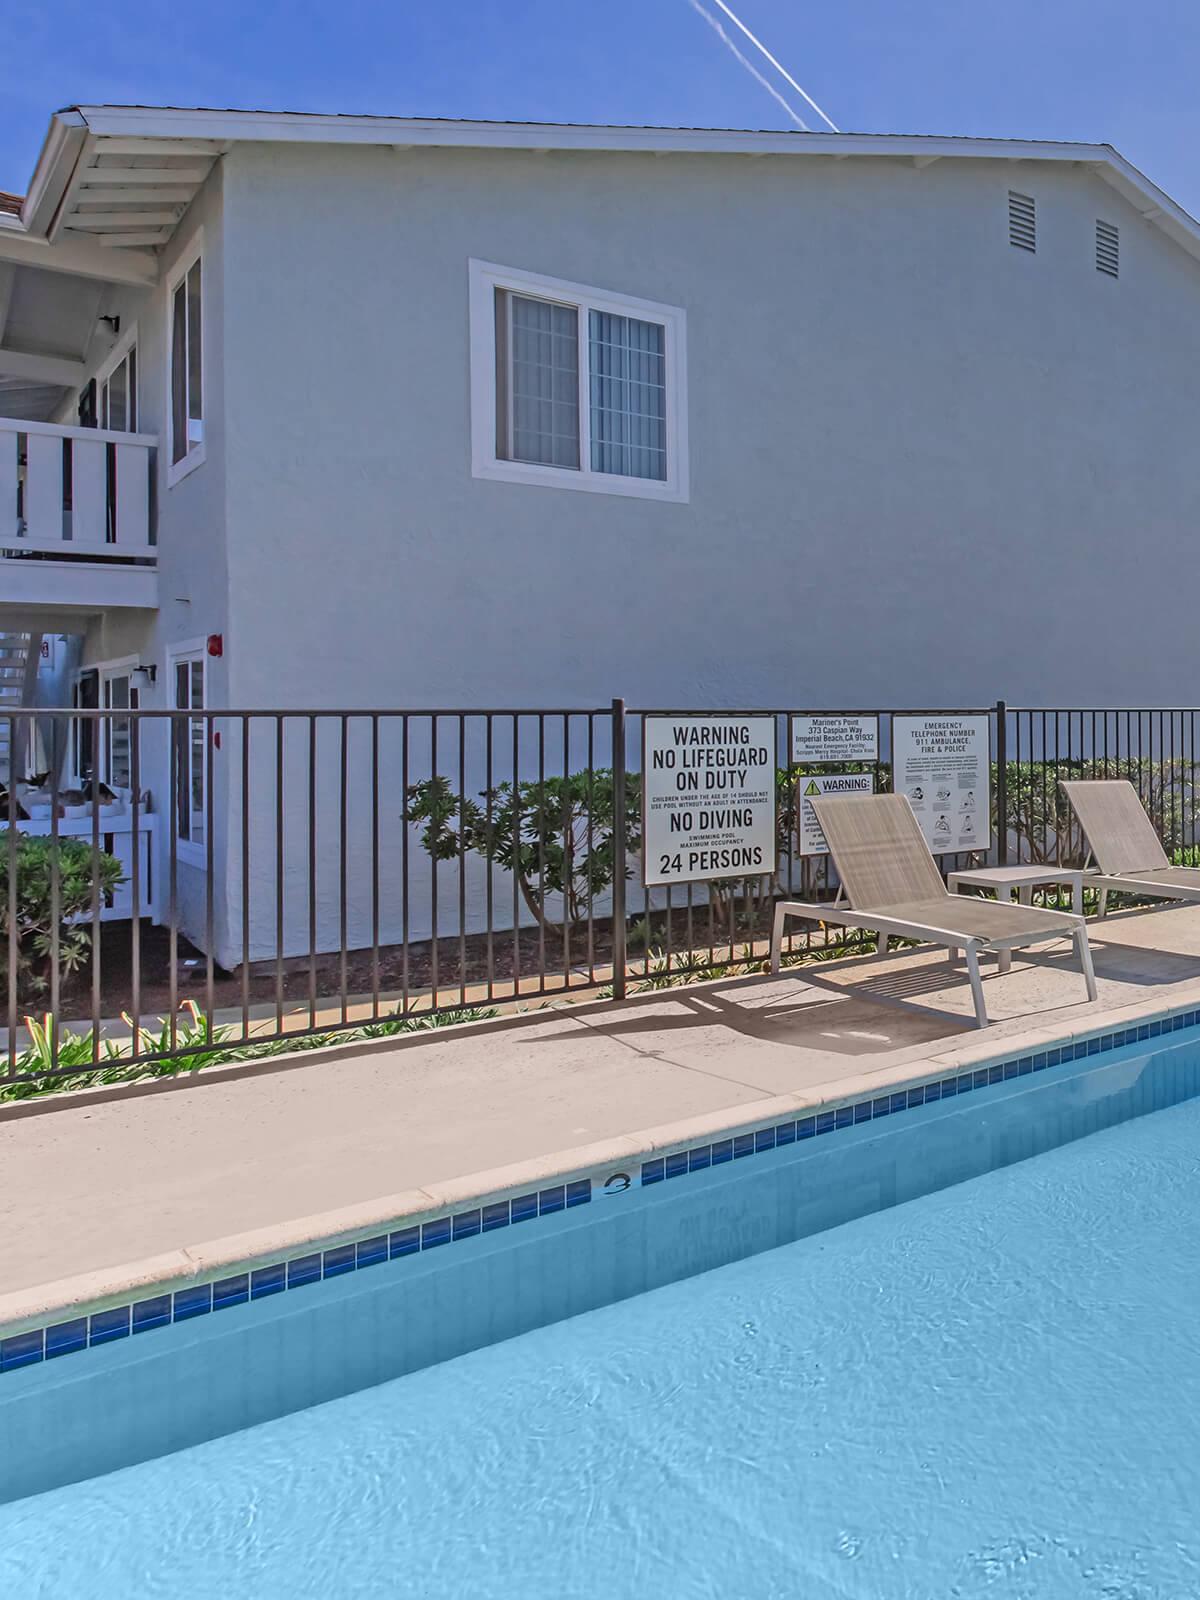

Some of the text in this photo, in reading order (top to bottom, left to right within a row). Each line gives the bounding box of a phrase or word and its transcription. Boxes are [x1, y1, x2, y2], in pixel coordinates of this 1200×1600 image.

[673, 726, 750, 746] WARNING
[823, 727, 848, 735] Caspian
[849, 727, 862, 735] Way
[653, 748, 768, 769] NO LIFEGUARD
[676, 770, 748, 791] ON DUTY
[822, 779, 870, 790] WARNING:
[671, 808, 753, 832] NO DIVING
[660, 846, 762, 874] 24 PERSONS
[604, 1173, 631, 1195] 3
